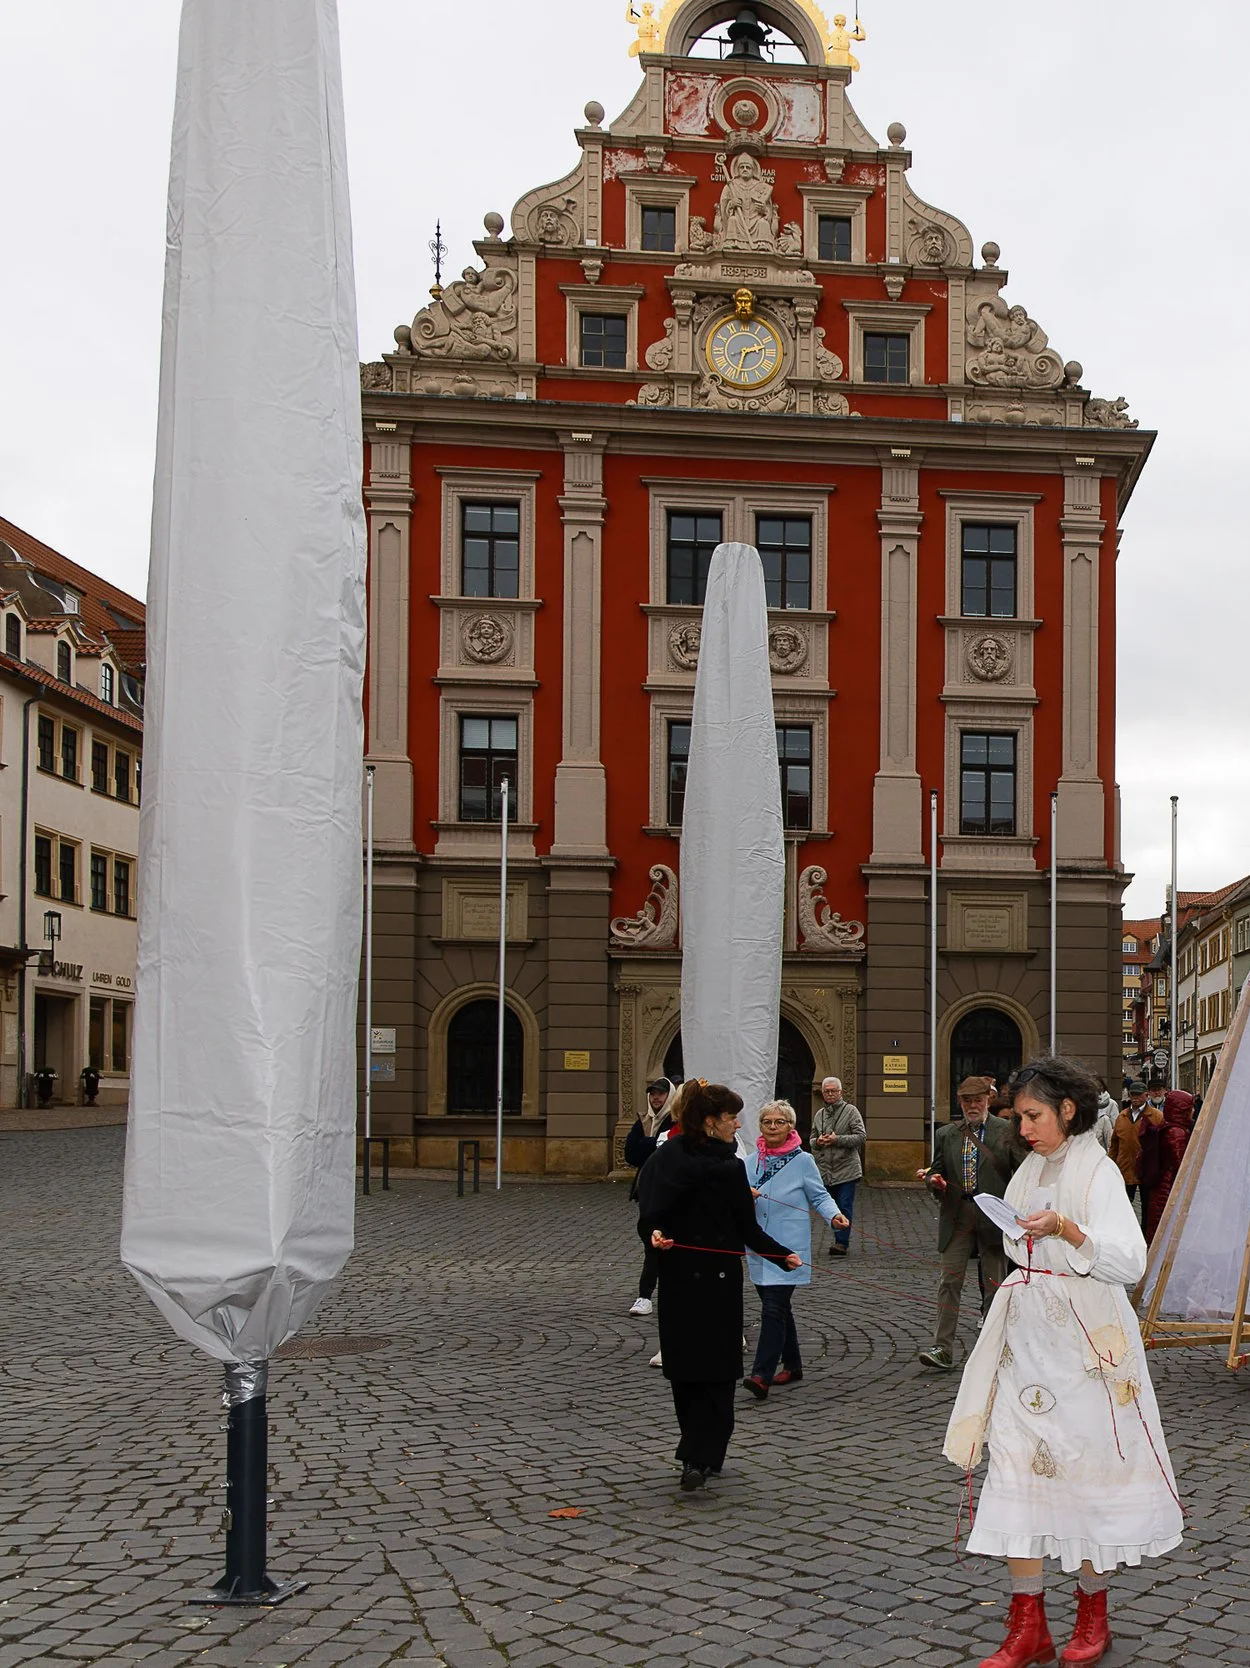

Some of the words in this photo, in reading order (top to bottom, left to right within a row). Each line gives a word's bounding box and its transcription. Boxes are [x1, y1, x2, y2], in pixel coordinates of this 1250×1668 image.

[53, 960, 83, 981] CHULZ
[92, 971, 112, 985] UHREN
[115, 976, 131, 988] GOLD
